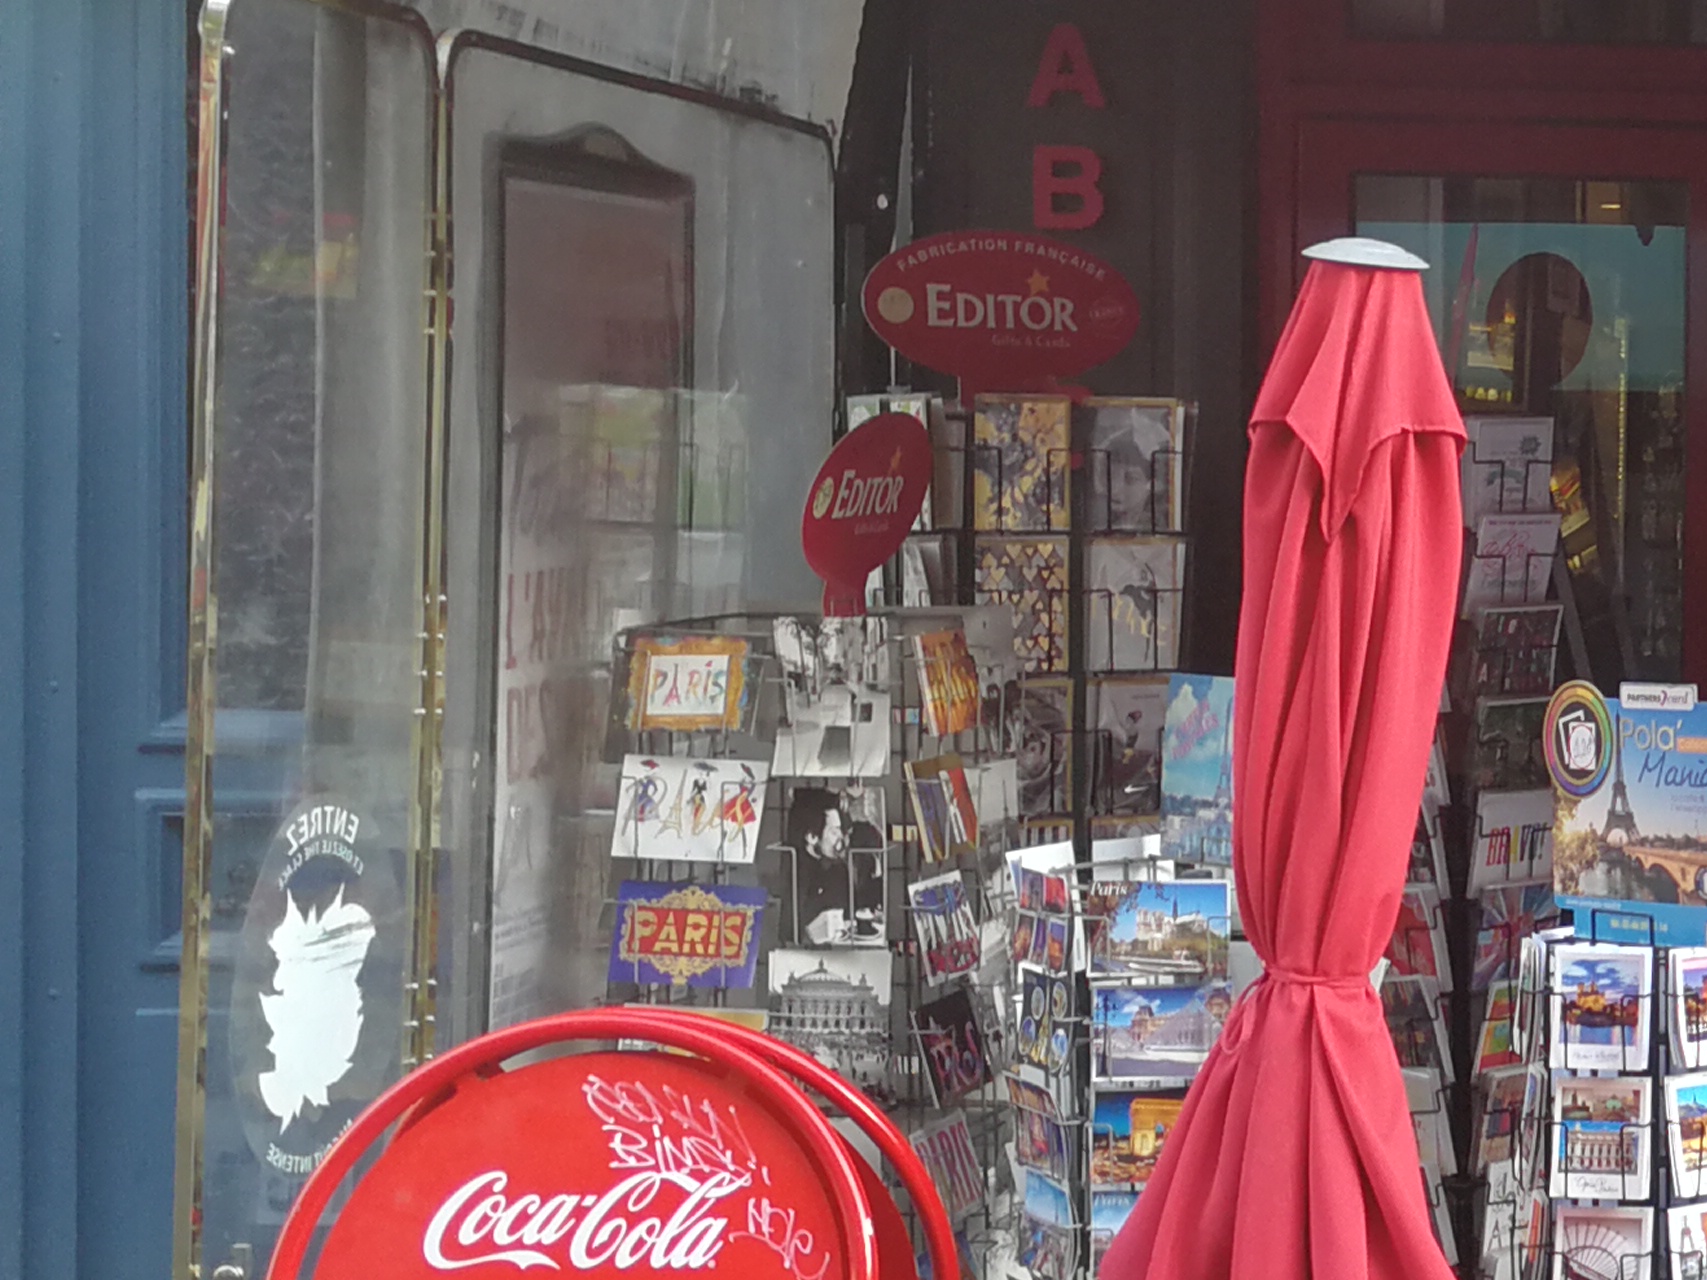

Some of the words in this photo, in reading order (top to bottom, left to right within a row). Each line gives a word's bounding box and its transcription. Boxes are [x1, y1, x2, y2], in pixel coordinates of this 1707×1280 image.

[831, 469, 904, 520] EDITOR
[1090, 880, 1128, 897] Paris
[422, 1170, 744, 1271] Coca-Cola
